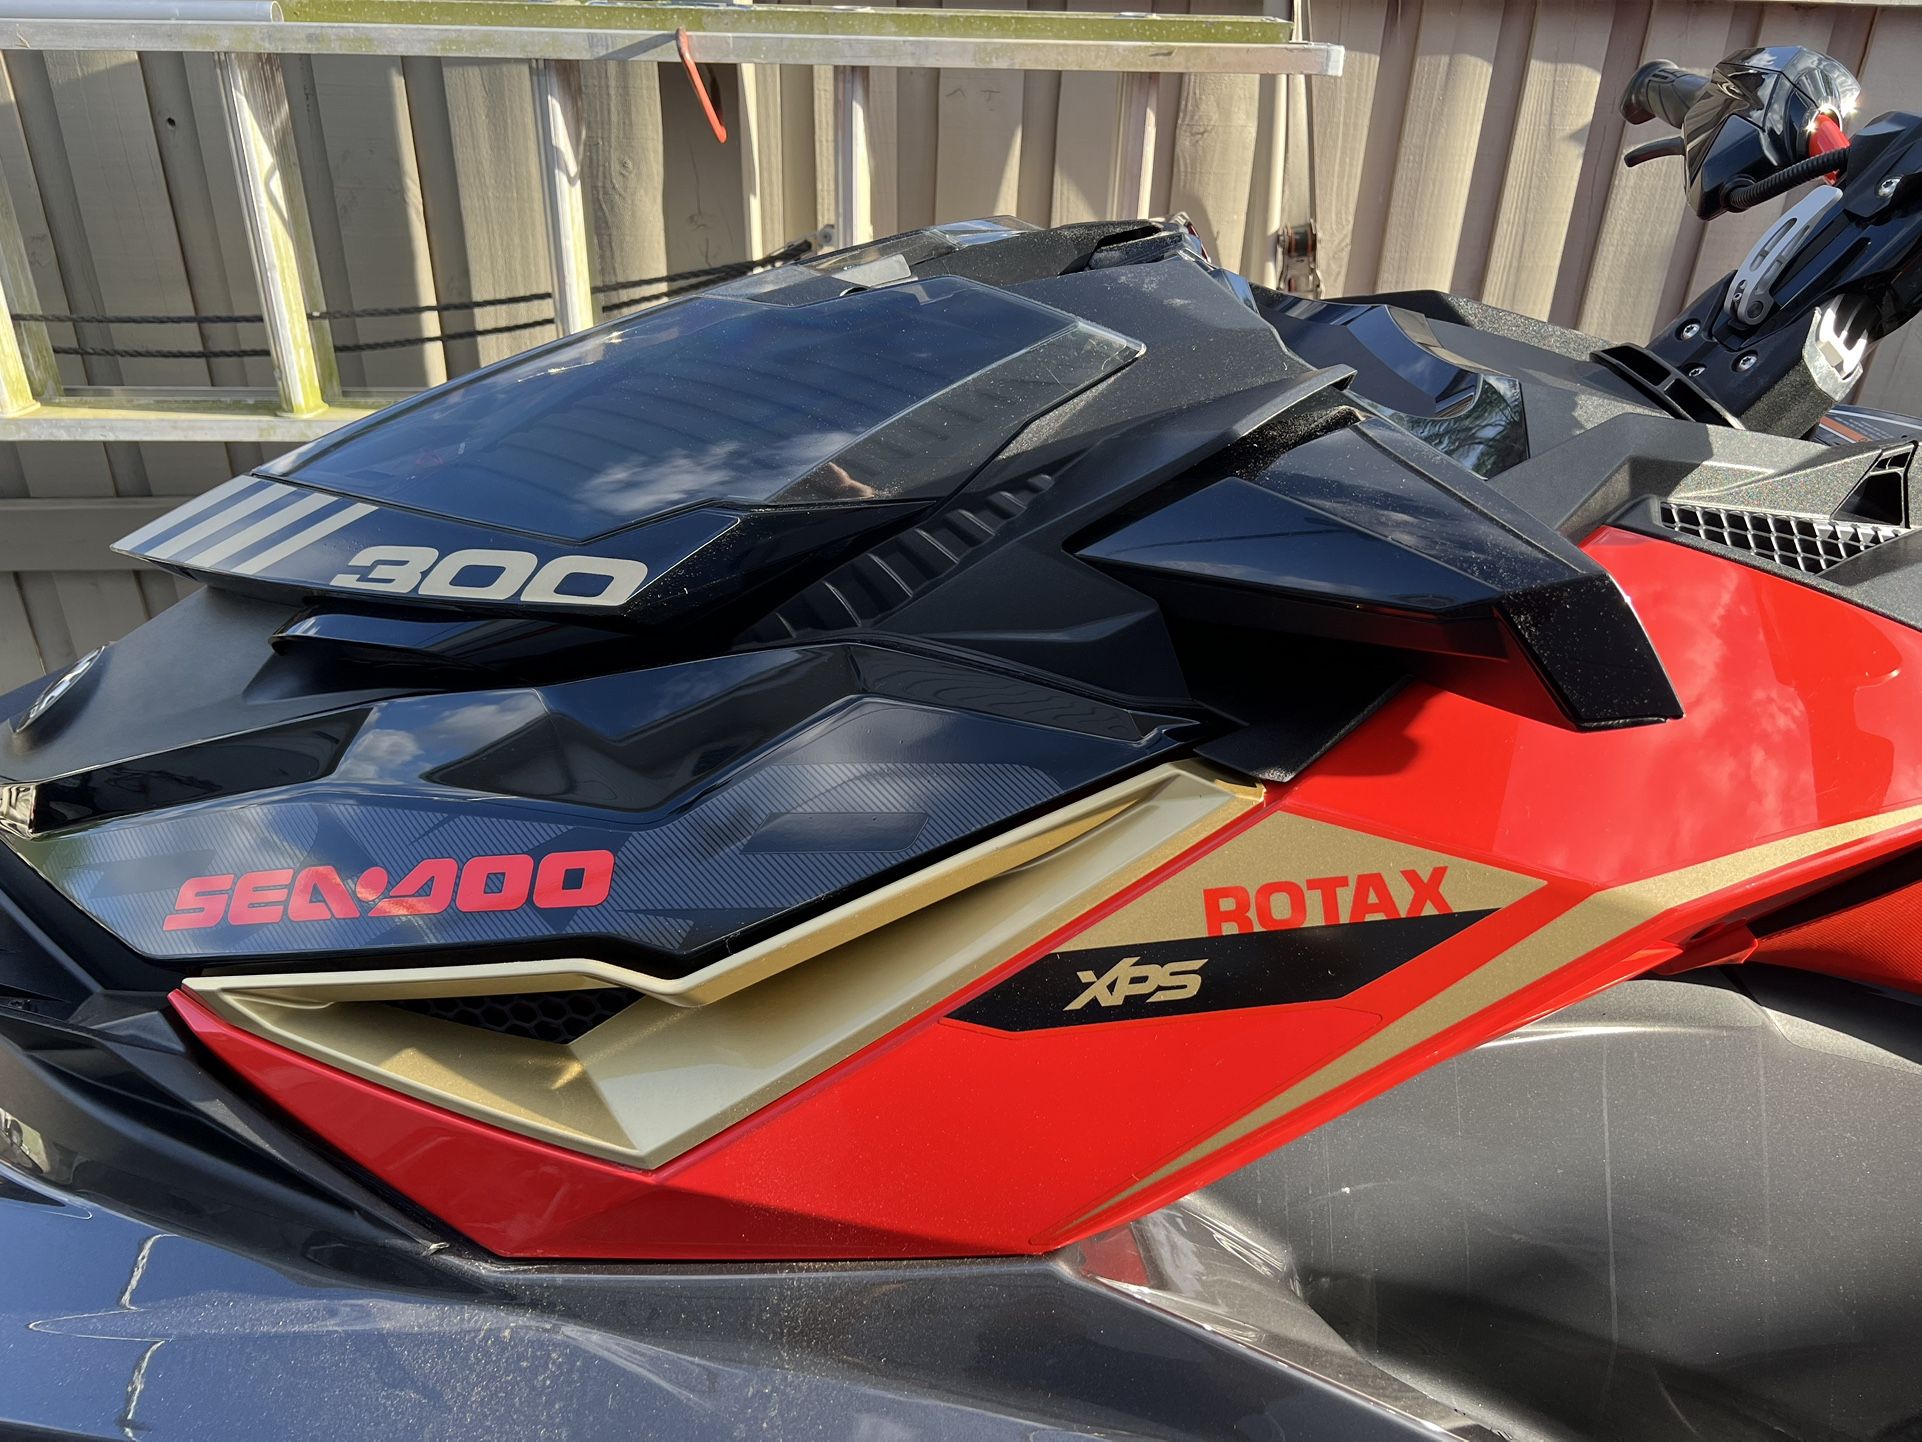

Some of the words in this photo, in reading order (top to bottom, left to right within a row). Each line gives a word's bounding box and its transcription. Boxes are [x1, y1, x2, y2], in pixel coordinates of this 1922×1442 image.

[329, 545, 648, 606] 300
[1203, 866, 1454, 937] ROTAX
[1063, 956, 1209, 1011] XPS
